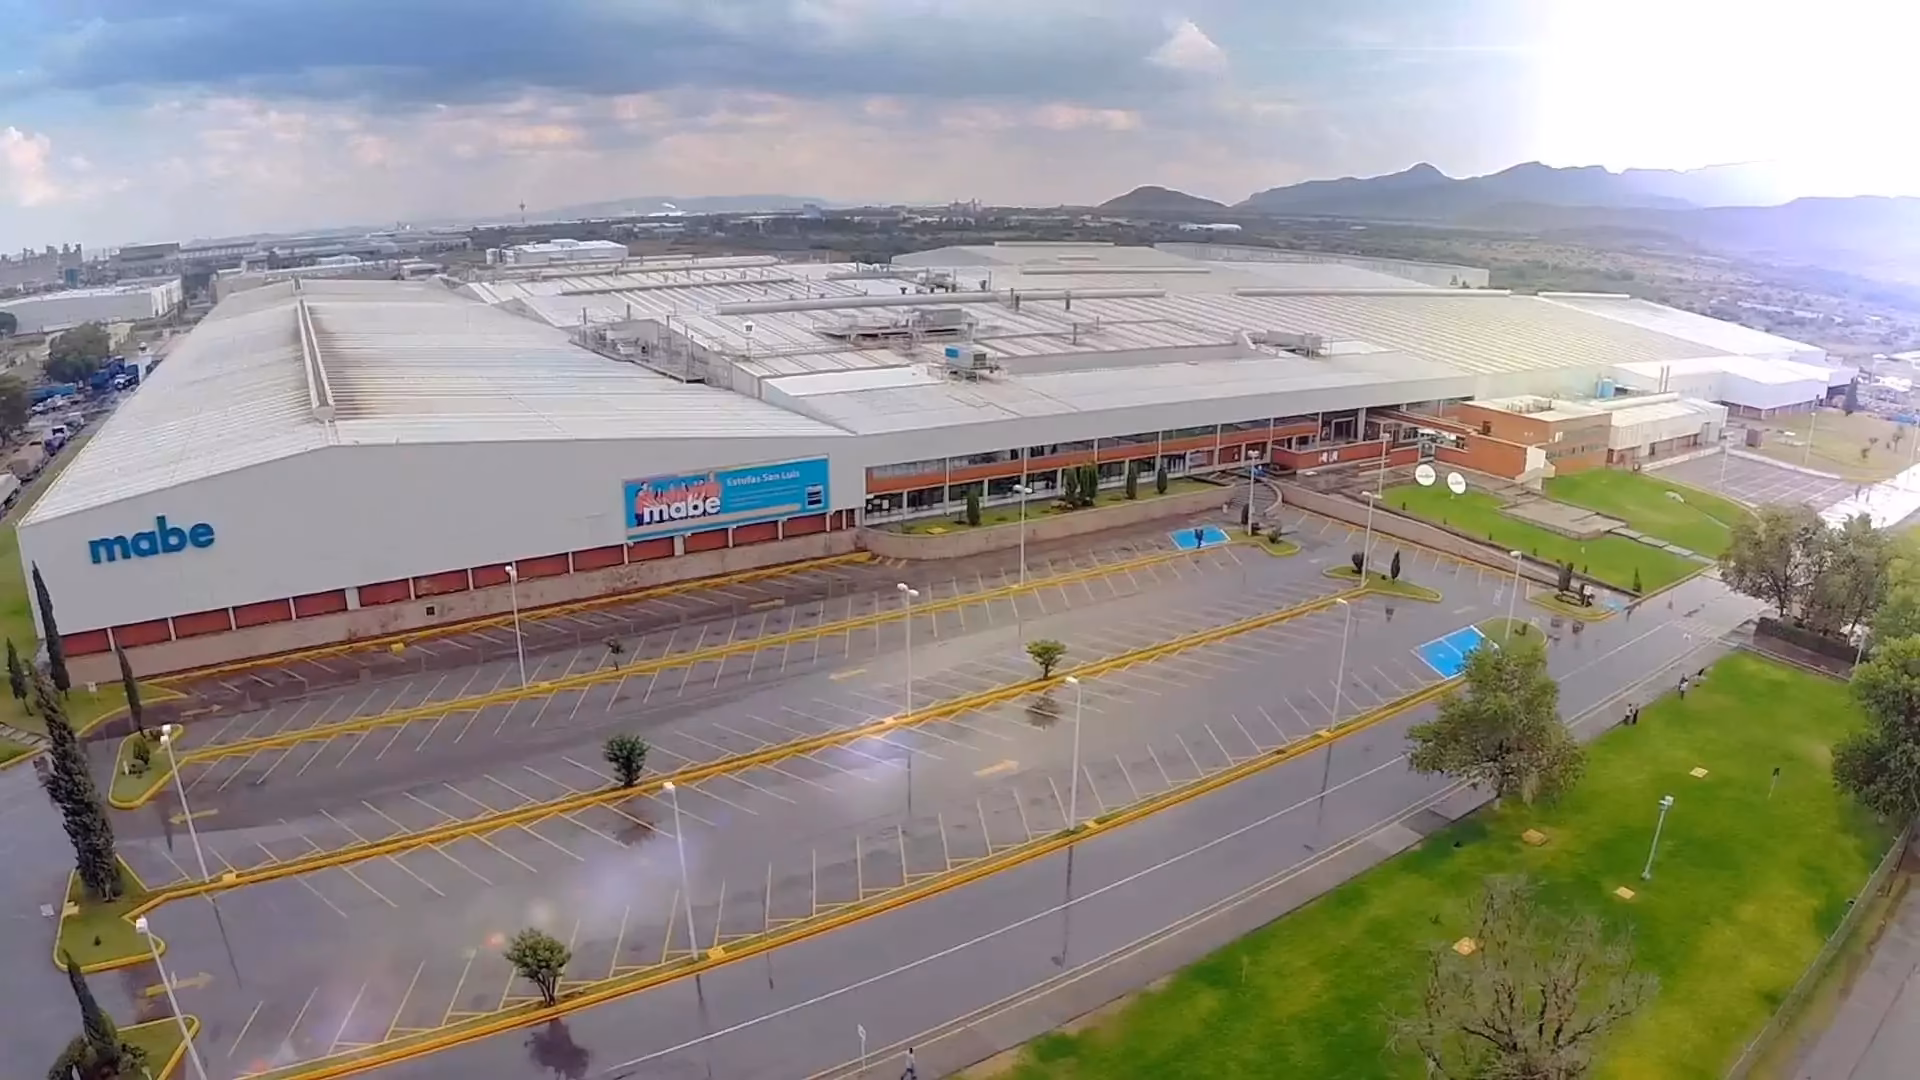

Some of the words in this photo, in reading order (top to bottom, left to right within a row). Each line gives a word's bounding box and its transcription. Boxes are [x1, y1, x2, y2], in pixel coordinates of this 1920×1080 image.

[762, 472, 780, 482] San
[781, 469, 800, 480] Luis
[643, 492, 721, 522] mabe
[88, 514, 215, 564] mabe
